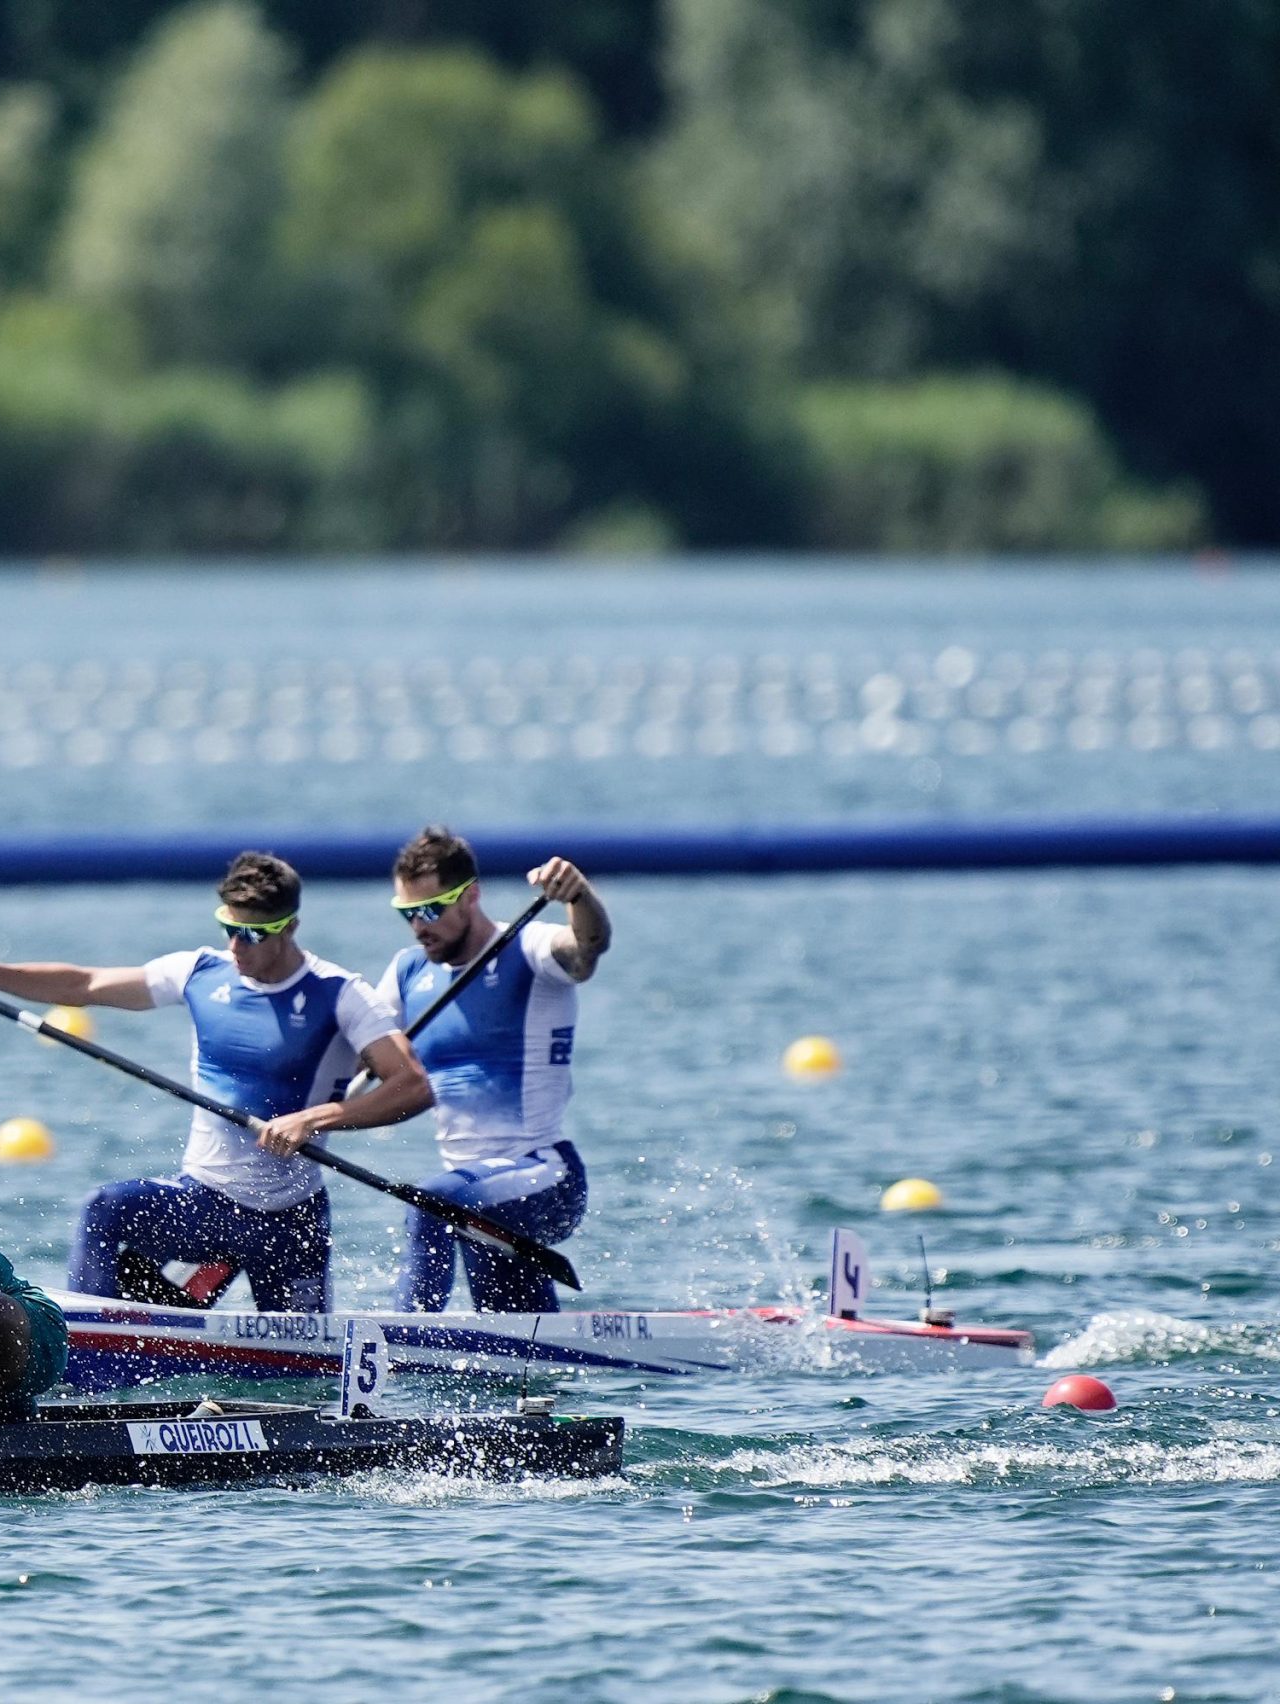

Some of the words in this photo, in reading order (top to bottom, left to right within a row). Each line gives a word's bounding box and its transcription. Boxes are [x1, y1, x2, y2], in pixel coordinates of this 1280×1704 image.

[844, 1252, 859, 1299] 4
[592, 1314, 631, 1338] BART
[357, 1342, 377, 1394] 5
[159, 1423, 245, 1452] QUEIROZ
